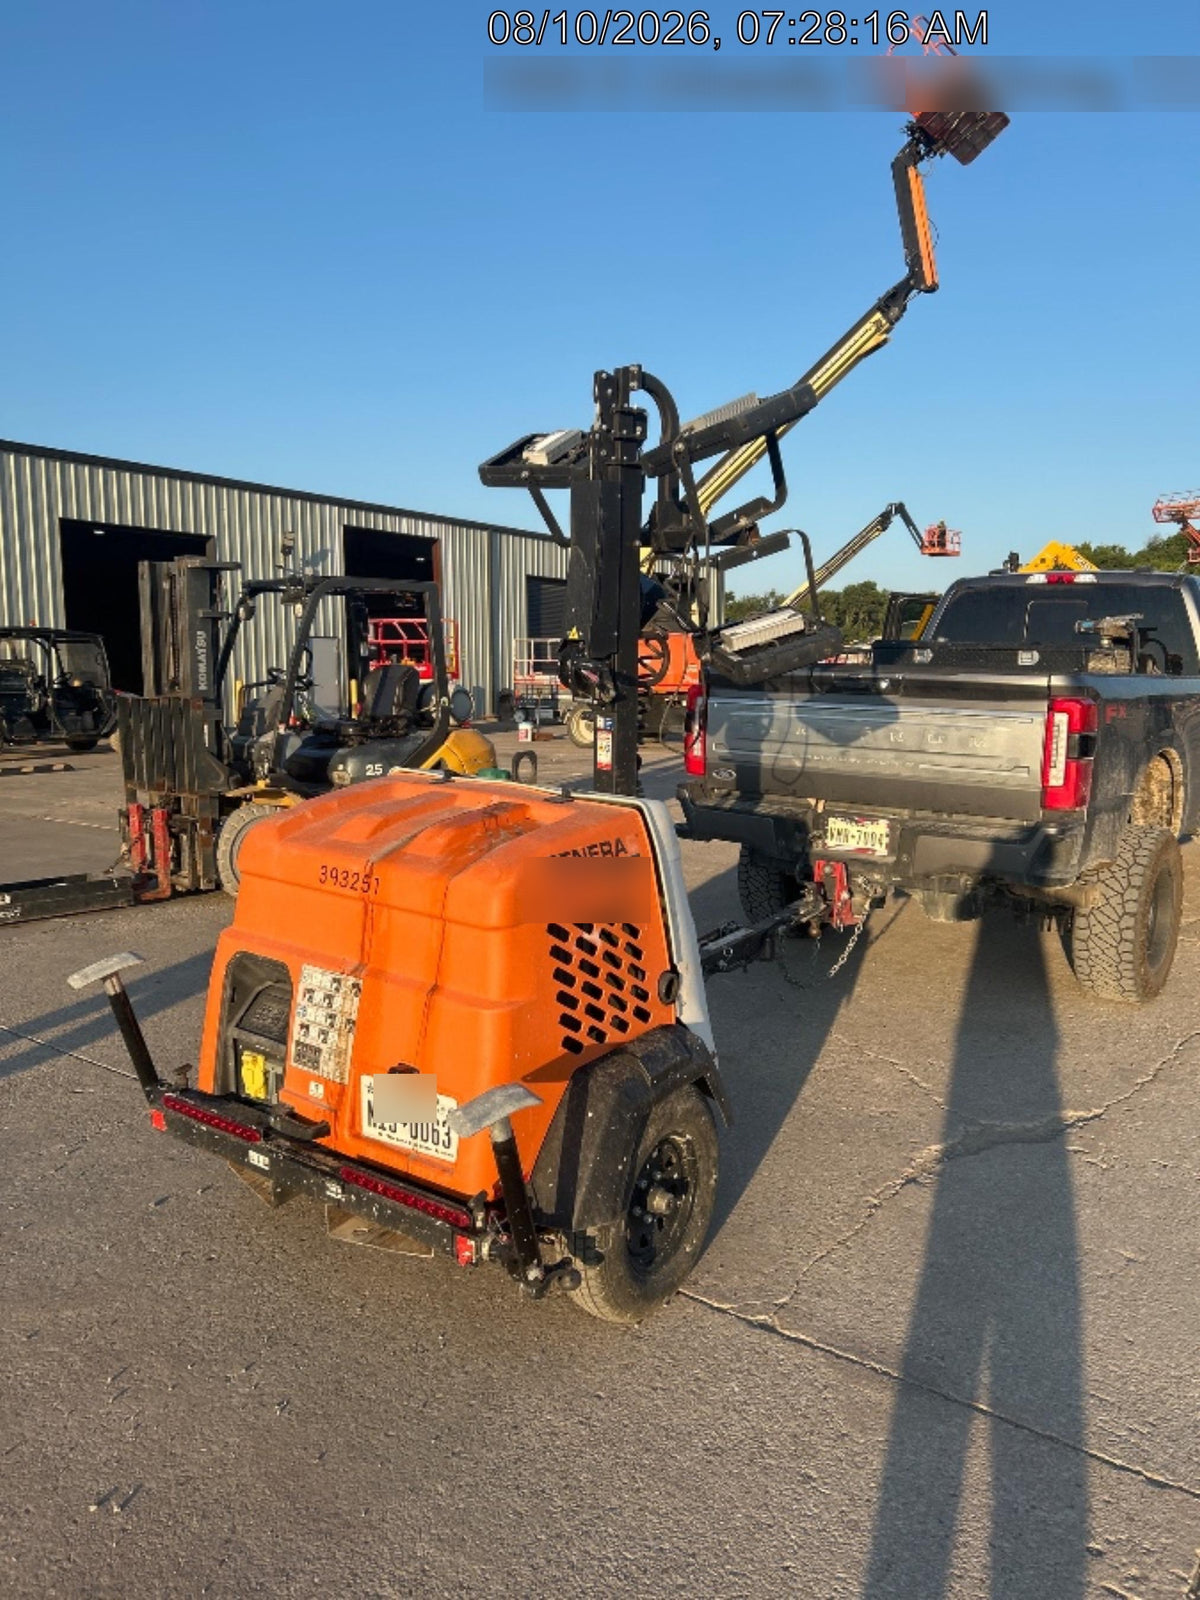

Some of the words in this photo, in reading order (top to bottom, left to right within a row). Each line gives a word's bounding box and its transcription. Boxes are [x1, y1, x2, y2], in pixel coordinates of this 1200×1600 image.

[195, 630, 208, 690] KOMATSU
[365, 764, 383, 776] 25
[319, 865, 380, 895] 393251
